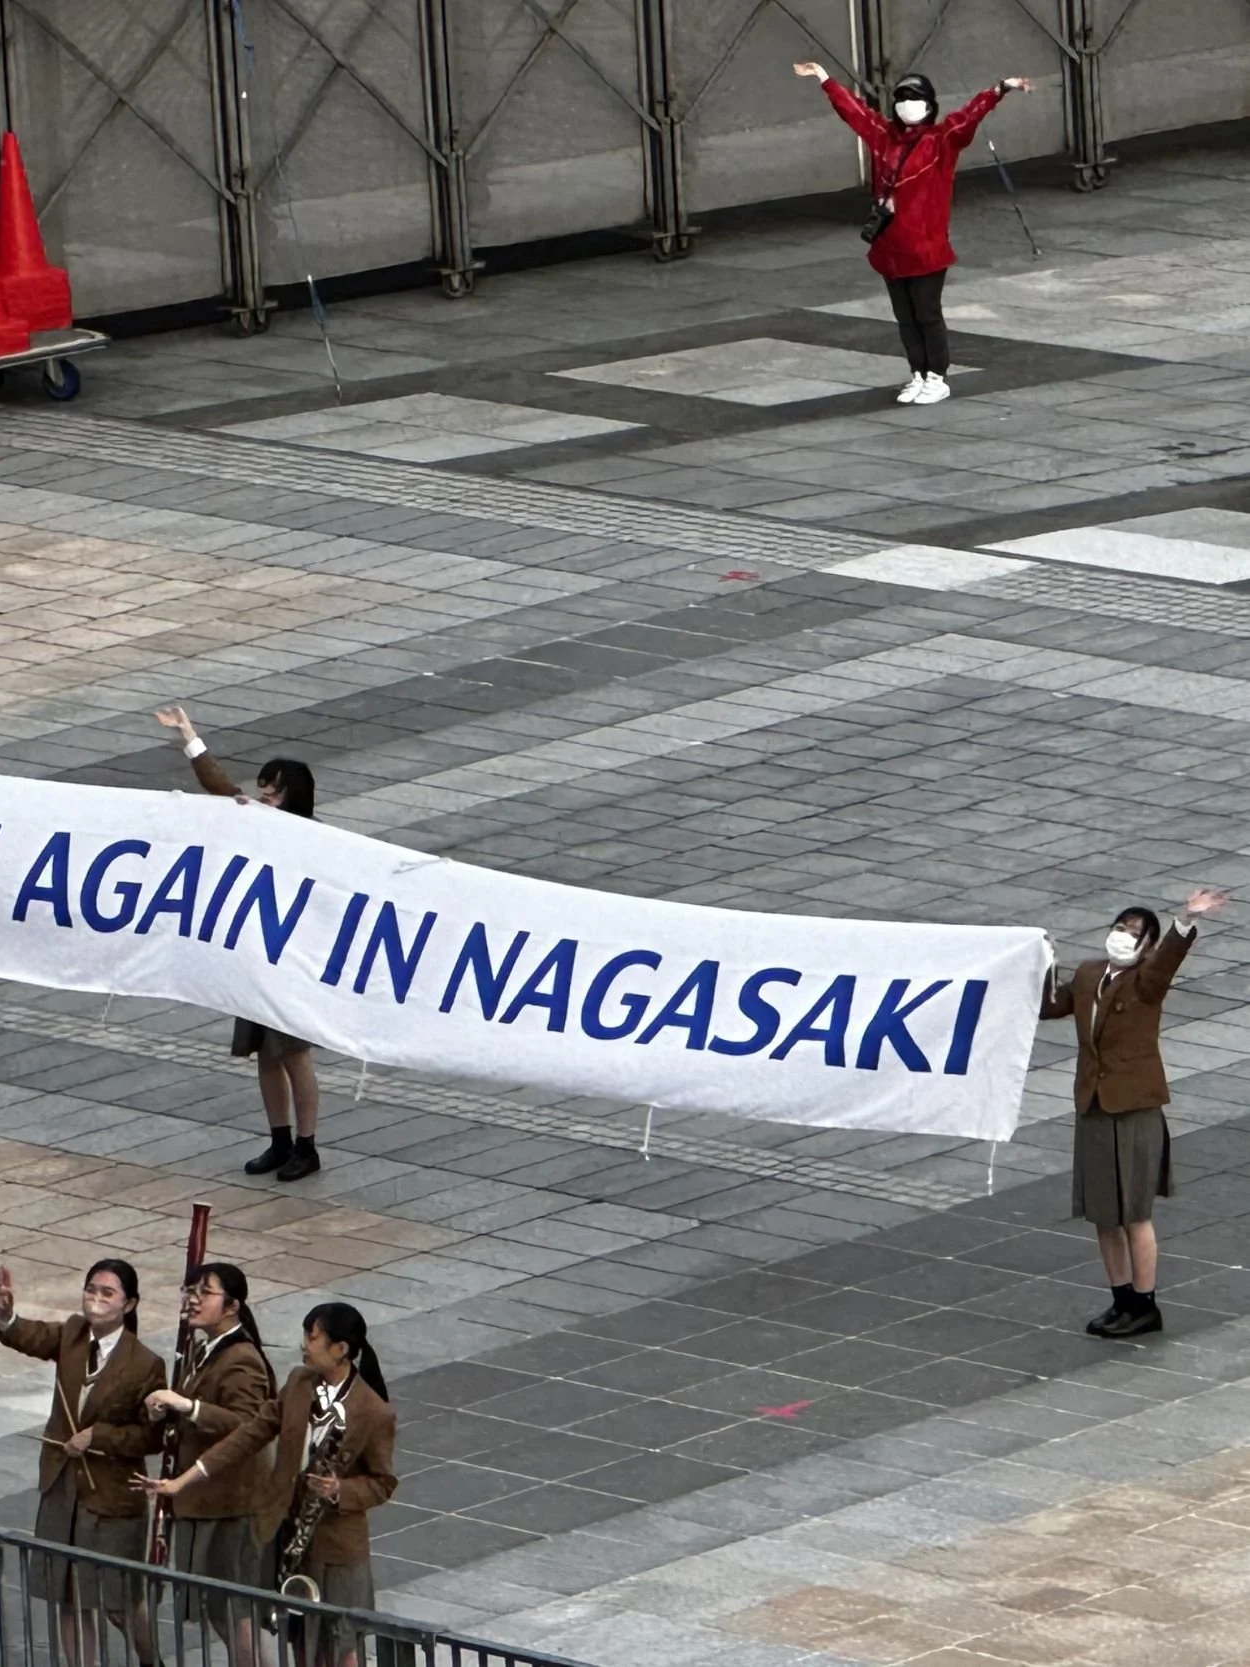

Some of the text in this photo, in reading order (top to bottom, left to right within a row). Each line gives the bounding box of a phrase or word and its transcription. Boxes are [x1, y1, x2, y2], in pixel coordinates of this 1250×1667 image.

[12, 831, 315, 965] AGAIN
[320, 892, 437, 1005] IN
[439, 922, 988, 1076] NAGASAKI
